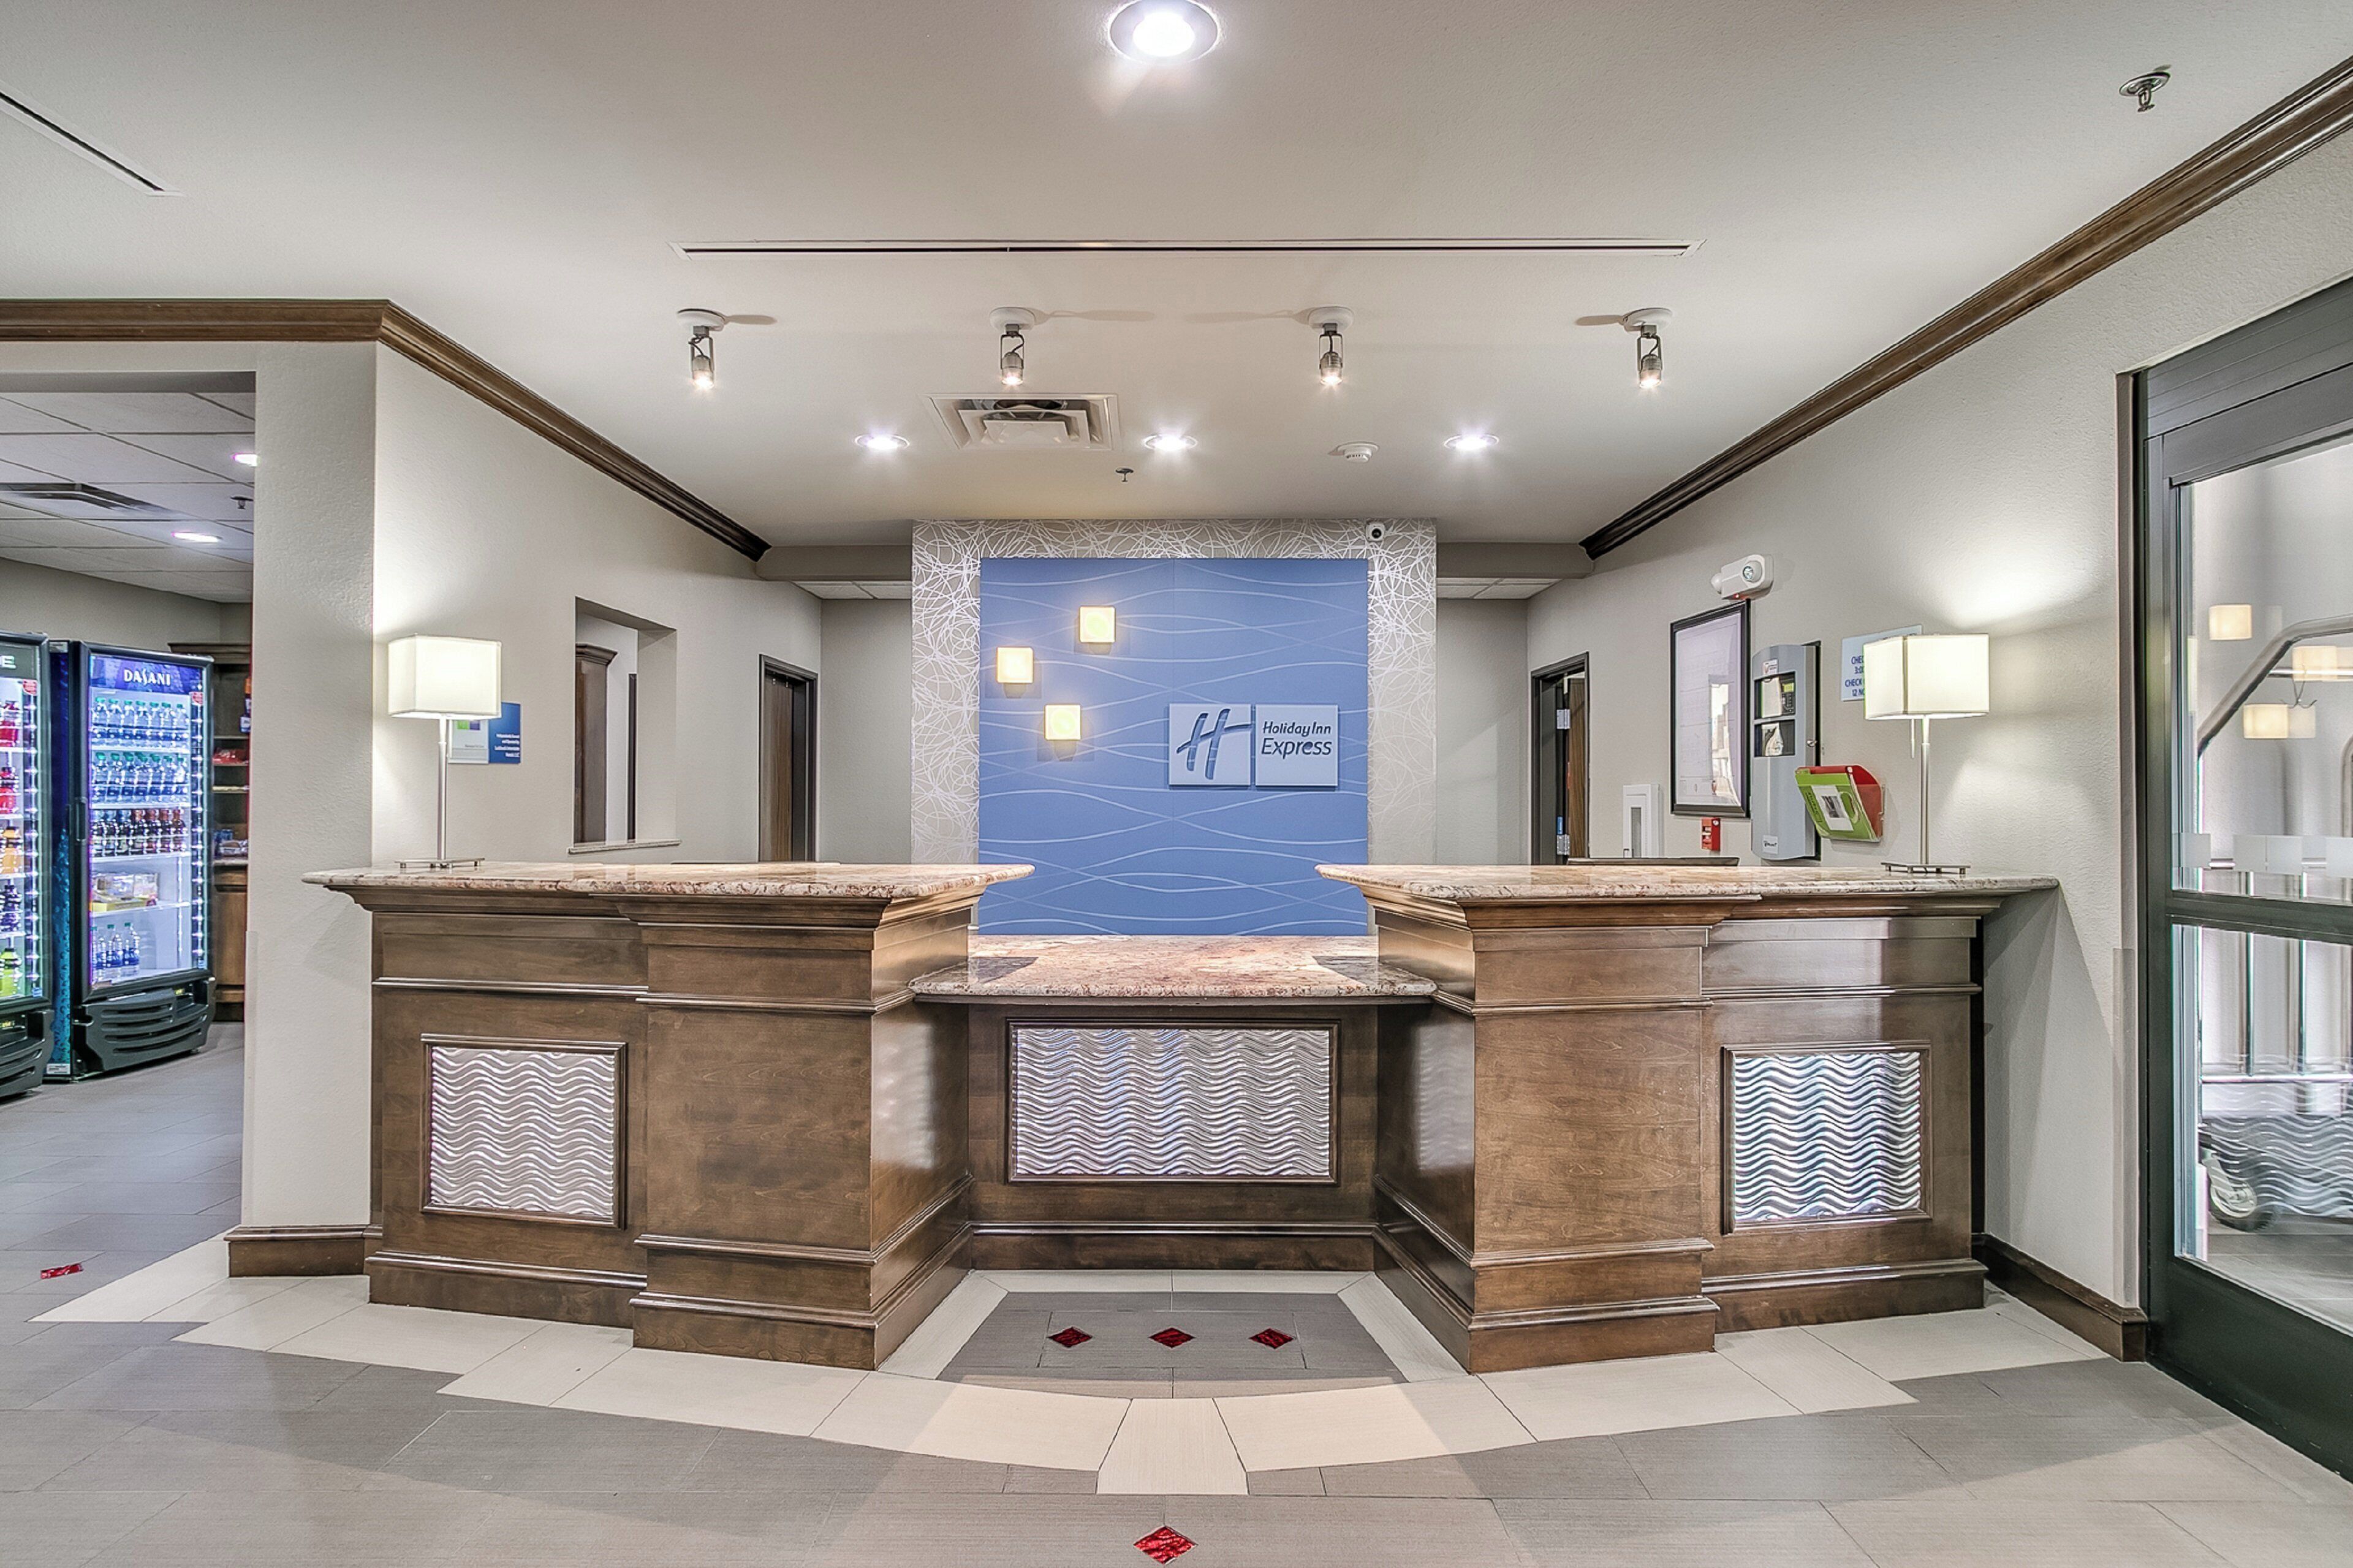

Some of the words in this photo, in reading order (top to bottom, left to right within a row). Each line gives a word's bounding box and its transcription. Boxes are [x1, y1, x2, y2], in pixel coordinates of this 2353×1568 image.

[124, 668, 171, 686] DASANI
[1845, 678, 1862, 687] CHECK
[1262, 721, 1311, 737] Holiday
[1311, 721, 1332, 734] Inn
[1261, 738, 1332, 759] Express
